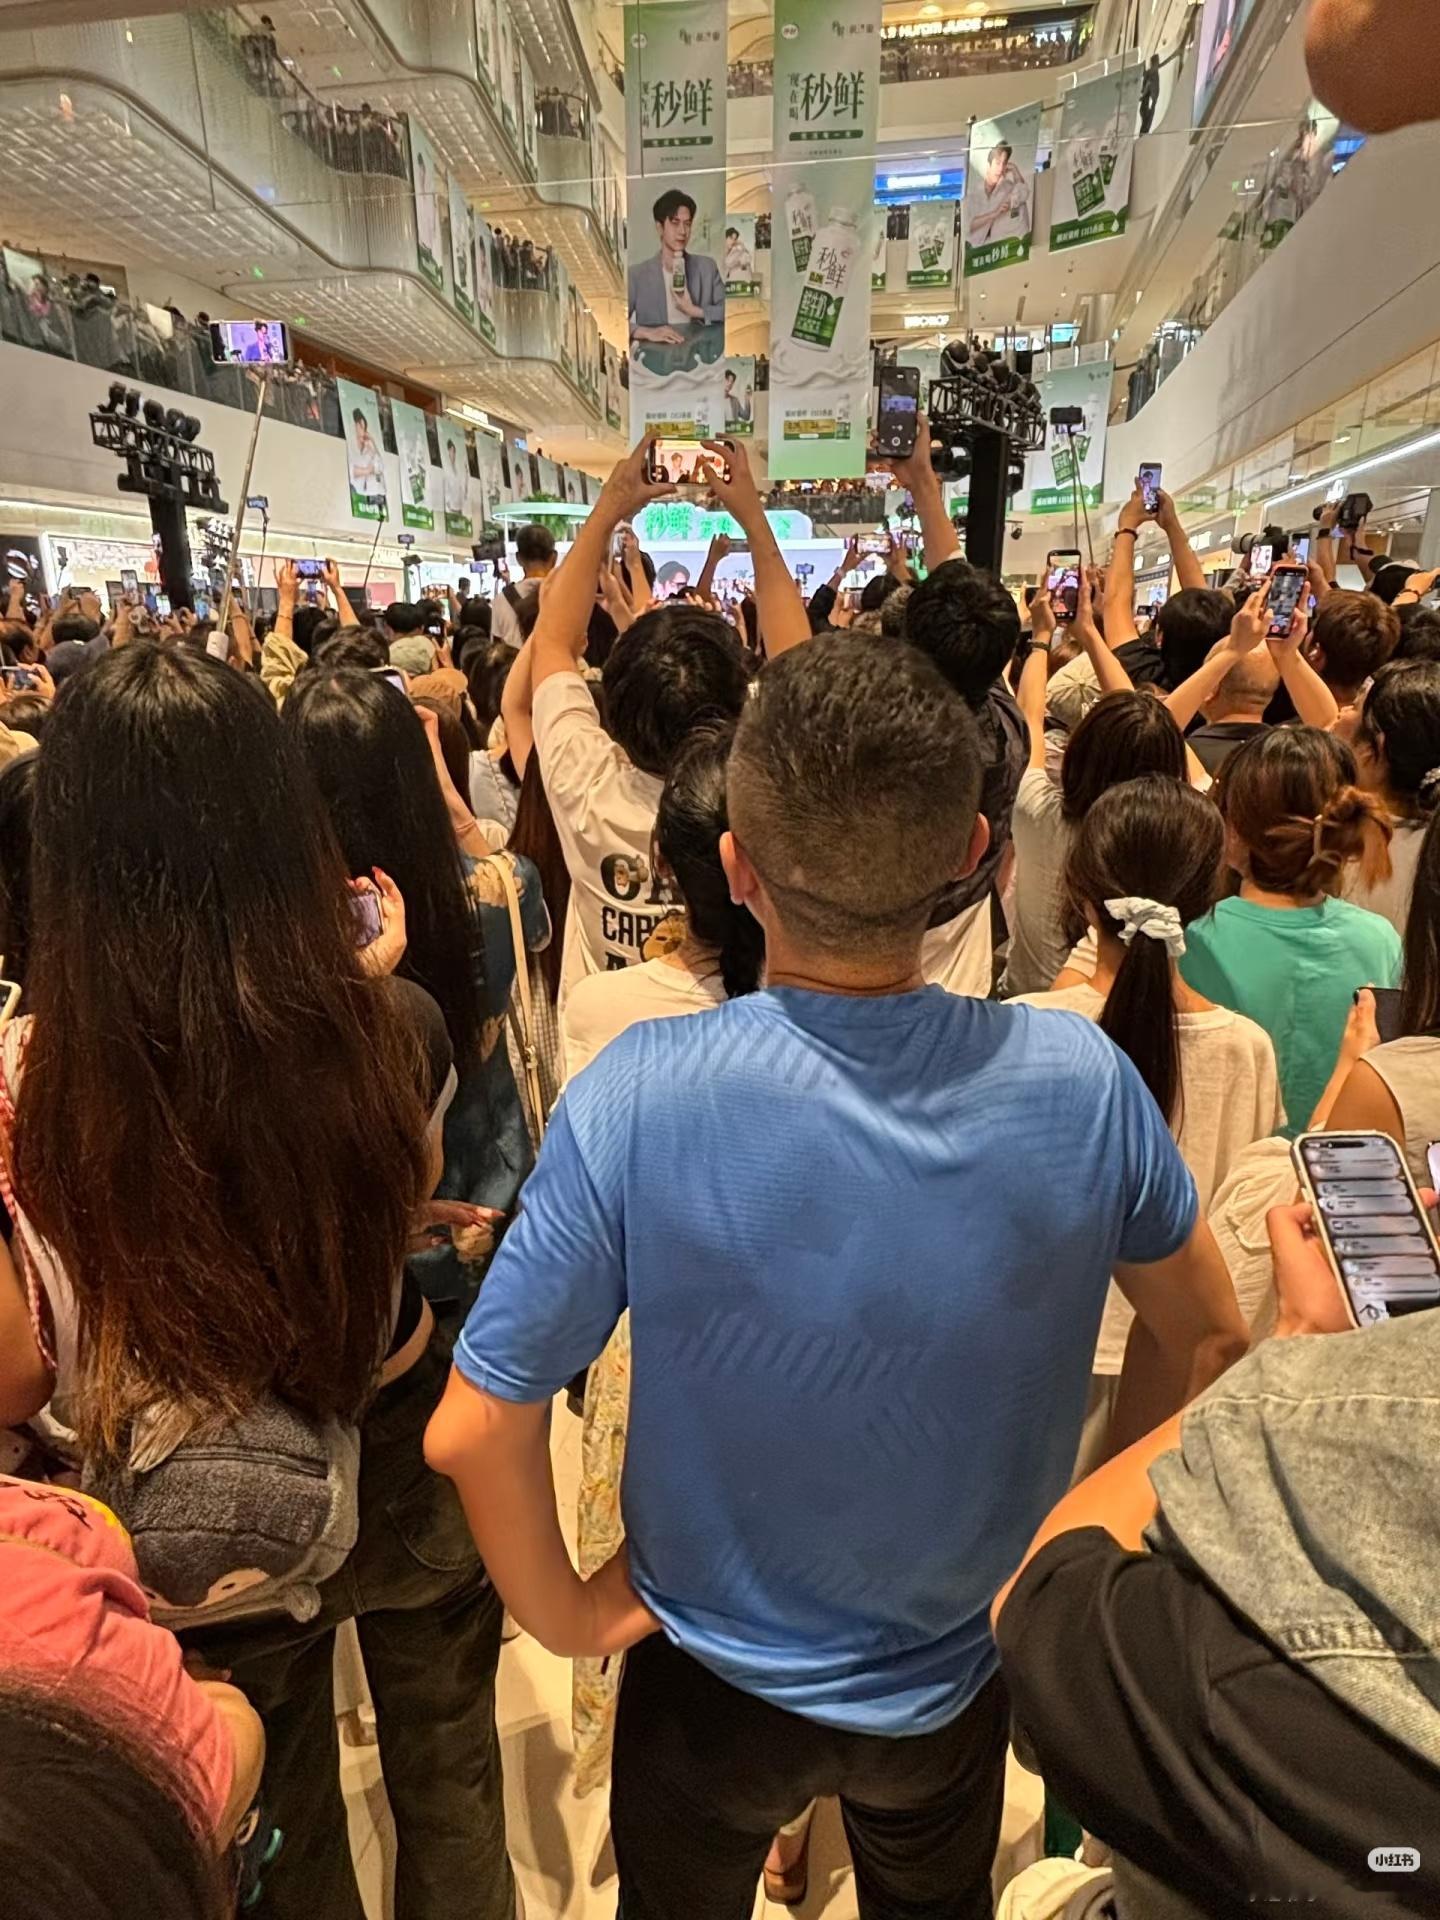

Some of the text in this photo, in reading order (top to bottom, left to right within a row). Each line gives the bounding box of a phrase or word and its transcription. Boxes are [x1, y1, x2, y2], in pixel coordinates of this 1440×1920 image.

[652, 78, 713, 129] 秒鲜
[800, 71, 865, 121] 秒鲜
[816, 246, 847, 289] 秒鲜
[602, 906, 661, 948] CAP
